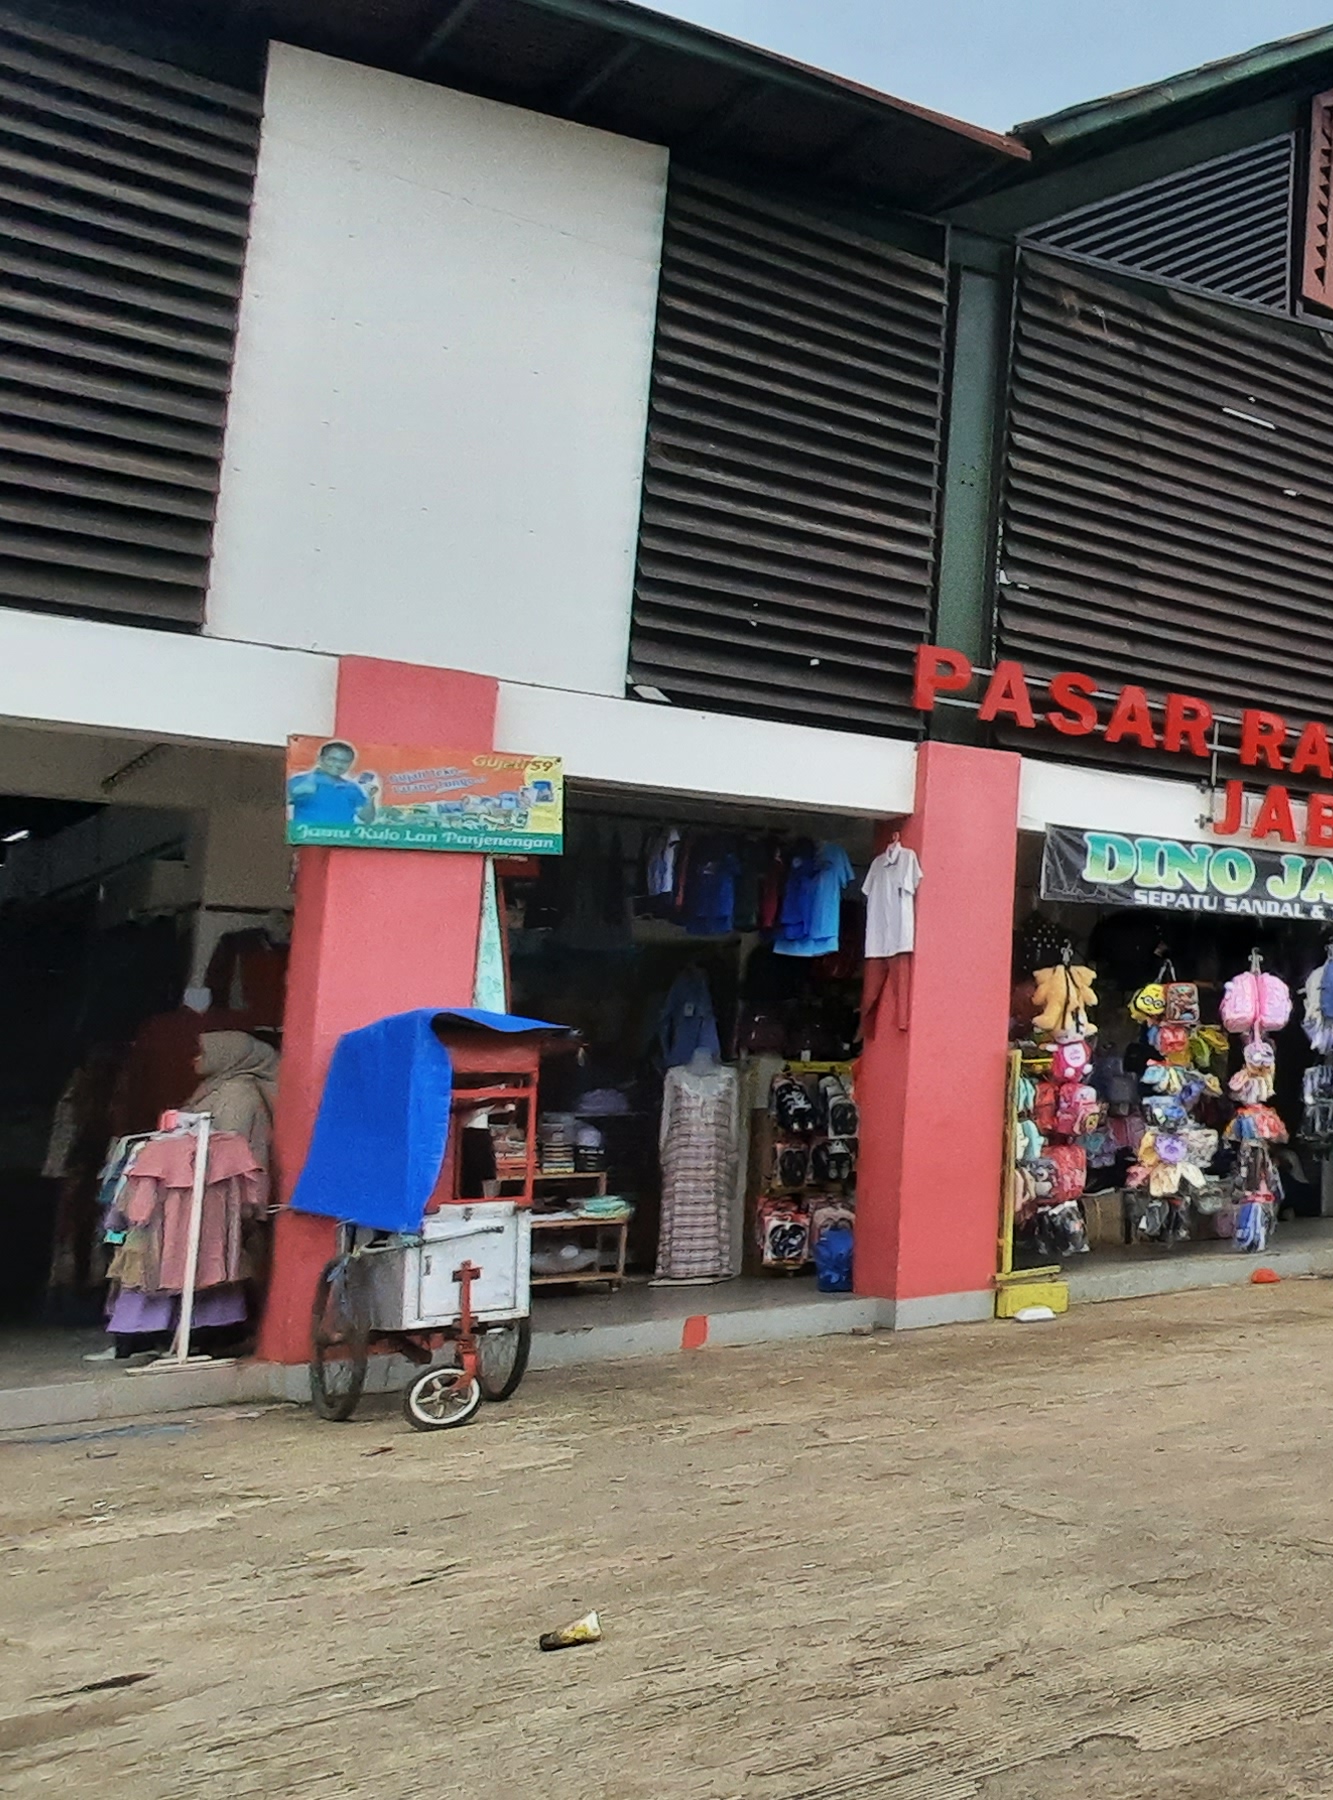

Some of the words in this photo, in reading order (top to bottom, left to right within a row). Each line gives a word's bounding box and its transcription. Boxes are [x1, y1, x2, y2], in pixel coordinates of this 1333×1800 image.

[913, 644, 1213, 757] PASAR
[297, 824, 349, 839] Jamu
[403, 830, 437, 843] Lan
[442, 832, 554, 849] Panjenengan
[1082, 831, 1257, 896] DINO
[1133, 890, 1218, 912] SEPATU
[1224, 897, 1304, 919] SANDAL
[1311, 907, 1326, 920] &
